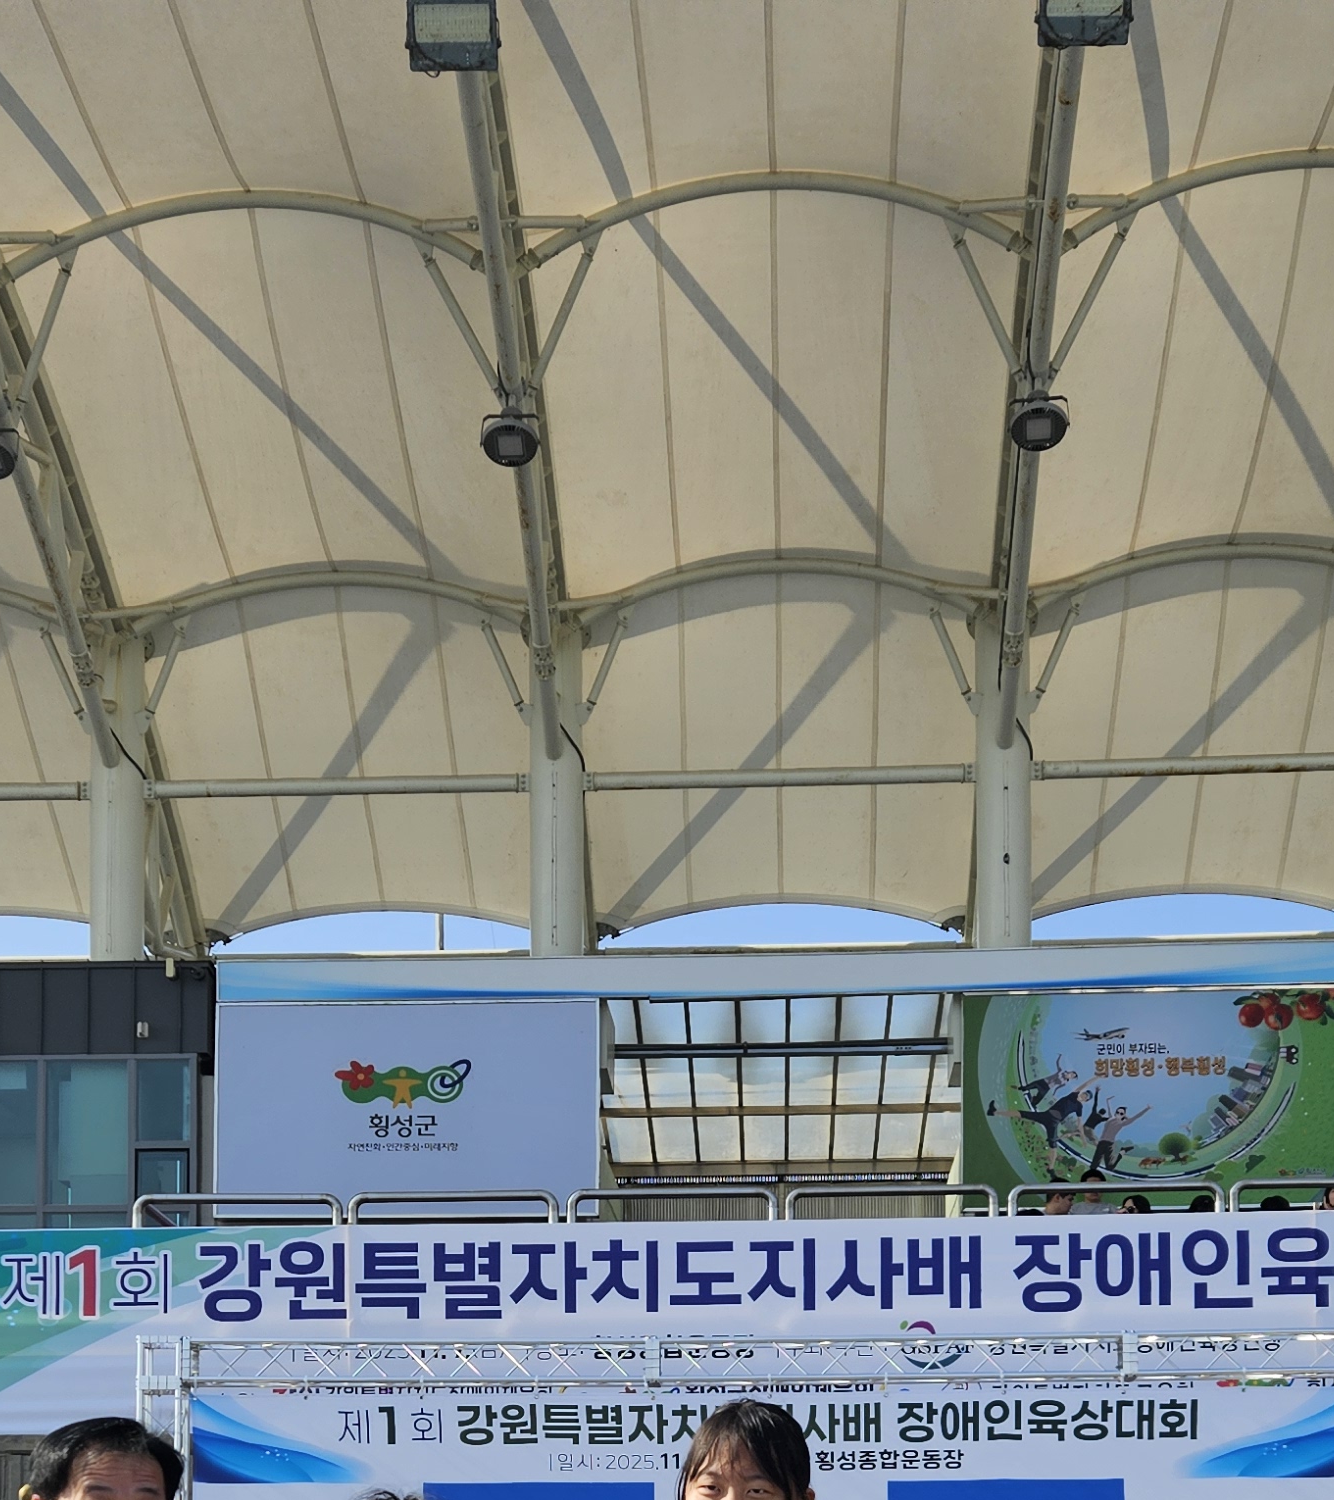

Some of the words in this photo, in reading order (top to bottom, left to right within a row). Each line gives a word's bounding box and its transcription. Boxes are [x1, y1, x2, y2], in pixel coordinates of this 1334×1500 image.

[1097, 1043, 1126, 1056] 군민이
[369, 1113, 439, 1138] 횡성군
[1, 1247, 170, 1319] 제1회
[194, 1239, 985, 1320] 강원특별자치도지사배
[456, 1401, 882, 1446] 강원특별자치사배
[896, 1399, 1199, 1442] 장애인육상대회
[605, 1452, 681, 1471] 2025.11
[814, 1448, 965, 1471] 횡성종합운동장
